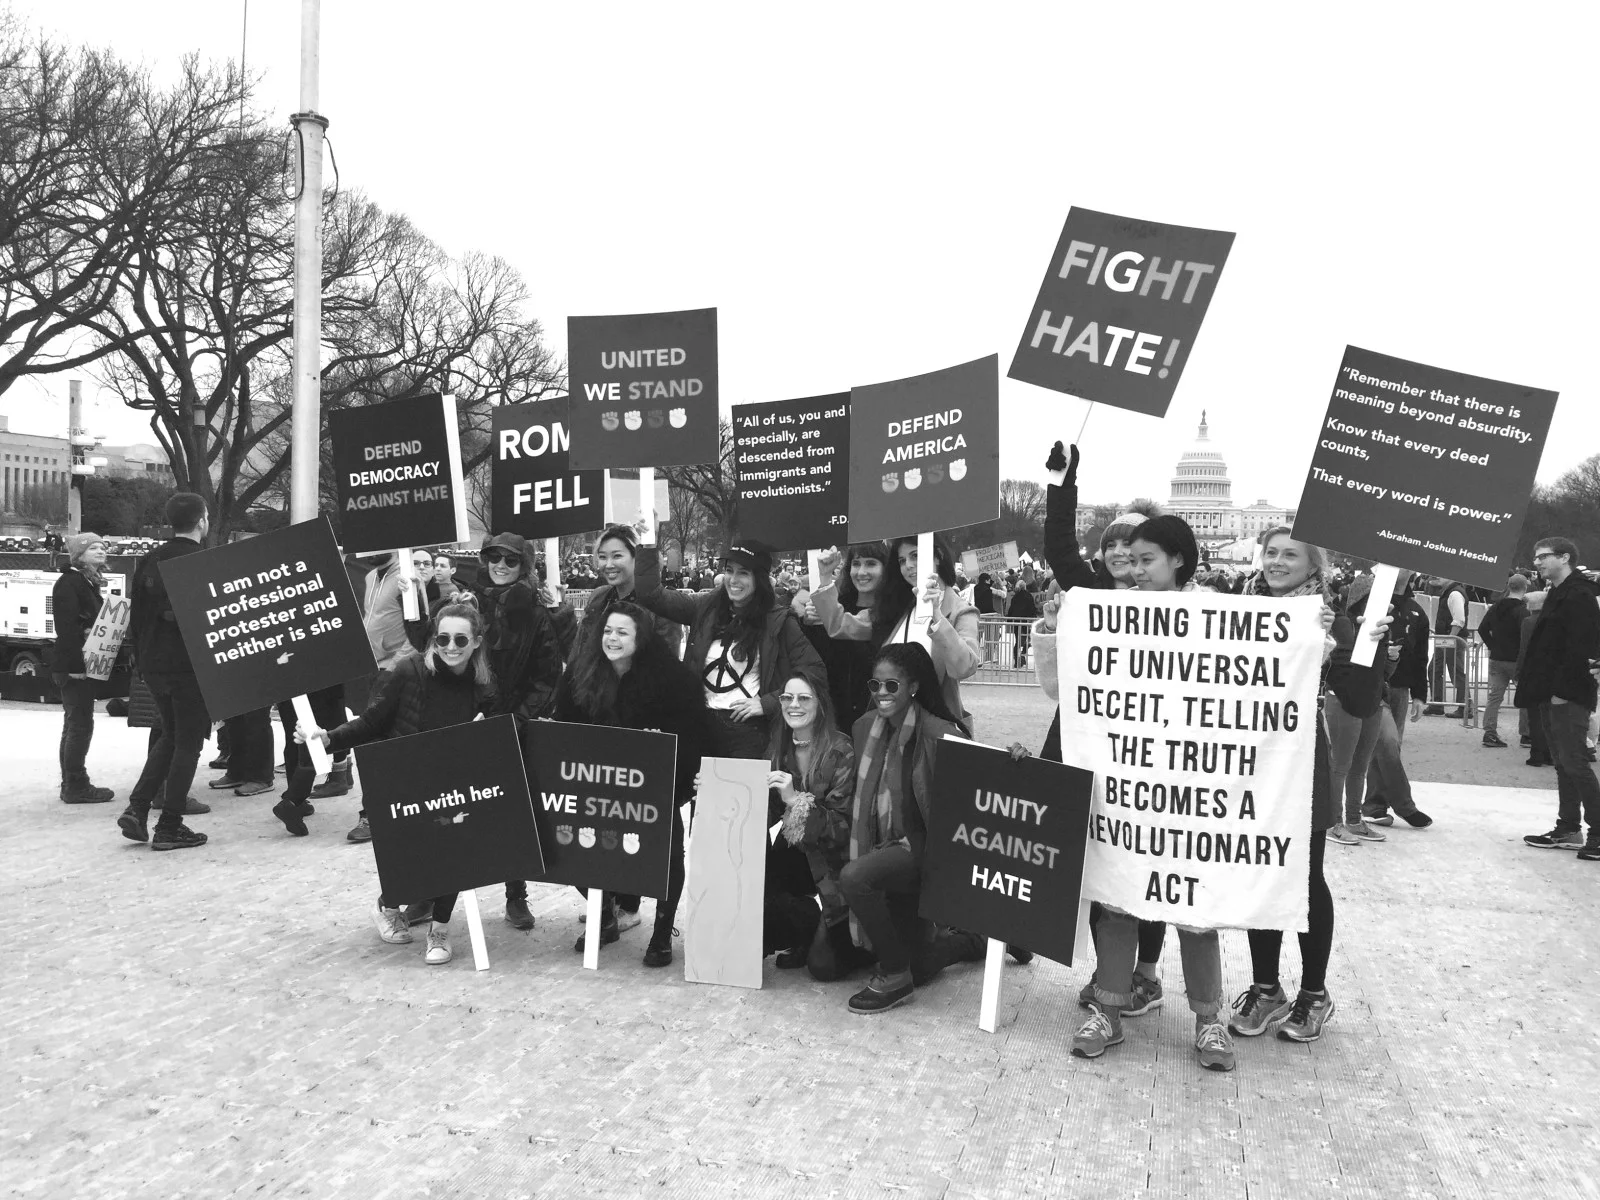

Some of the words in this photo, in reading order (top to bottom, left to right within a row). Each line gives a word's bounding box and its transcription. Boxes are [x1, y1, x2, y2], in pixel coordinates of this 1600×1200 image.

[1058, 239, 1216, 304] FIGHT
[601, 347, 687, 370] UNITED
[1030, 309, 1181, 379] HATE!
[583, 382, 622, 402] WE
[628, 378, 704, 401] STAND
[1343, 366, 1427, 398] "Remember
[1429, 389, 1461, 406] that
[1464, 396, 1505, 415] there
[1508, 405, 1521, 419] is
[736, 414, 760, 428] "All
[762, 413, 777, 426] of
[777, 412, 797, 425] us,
[798, 411, 821, 425] you
[824, 404, 846, 419] and
[887, 408, 963, 438] DEFEND
[1335, 388, 1396, 414] meaning
[1398, 401, 1456, 425] beyond
[1457, 416, 1533, 444] absurdity.
[364, 439, 422, 461] DEFEND
[737, 429, 798, 448] especially,
[801, 429, 821, 440] are
[738, 446, 804, 464] descended
[806, 445, 835, 457] from
[881, 433, 968, 465] AMERICA
[1320, 439, 1370, 461] counts,
[1326, 416, 1368, 438] Know
[1371, 429, 1401, 447] that
[1403, 439, 1447, 459] every
[1449, 447, 1490, 467] deed
[349, 460, 440, 487] DEMOCRACY
[739, 466, 807, 482] immigrants
[809, 461, 832, 475] and
[741, 480, 832, 499] revolutionists."
[346, 490, 410, 511] AGAINST
[413, 485, 448, 503] HATE
[513, 474, 590, 515] FELL
[1312, 466, 1344, 486] That
[1346, 479, 1388, 500] every
[1391, 490, 1431, 507] word
[1432, 497, 1446, 511] is
[1448, 504, 1513, 524] power."
[1376, 529, 1422, 546] -Abraham
[1422, 540, 1457, 555] Joshua
[1458, 547, 1498, 564] Heschel
[208, 582, 218, 598] I
[222, 576, 253, 595] am
[256, 563, 292, 585] not
[295, 560, 308, 573] a
[100, 598, 131, 626] MY
[205, 572, 324, 626] professional
[93, 624, 108, 638] IS
[205, 607, 297, 649] protester
[302, 590, 339, 616] and
[1089, 603, 1189, 638] DURING
[1201, 609, 1291, 643] TIMES
[213, 633, 285, 665] neither
[287, 626, 306, 642] is
[309, 616, 343, 636] she
[1087, 645, 1119, 676] OF
[1129, 648, 1286, 688] UNIVERSAL
[1077, 685, 1169, 728] DECEIT,
[1182, 696, 1299, 733] TELLING
[1107, 732, 1155, 768] THE
[1165, 739, 1257, 776] TRUTH
[560, 761, 645, 788] UNITED
[389, 802, 421, 820] I'm
[423, 789, 466, 812] with
[469, 785, 505, 802] her.
[540, 791, 578, 815] WE
[584, 796, 659, 824] STAND
[974, 788, 1049, 826] UNITY
[1105, 775, 1228, 819] BECOMES
[1238, 790, 1256, 820] A
[952, 823, 1060, 869] AGAINST
[1088, 812, 1292, 867] EVOLUTIONARY
[971, 864, 1033, 903] HATE
[1145, 870, 1200, 907] ACT
